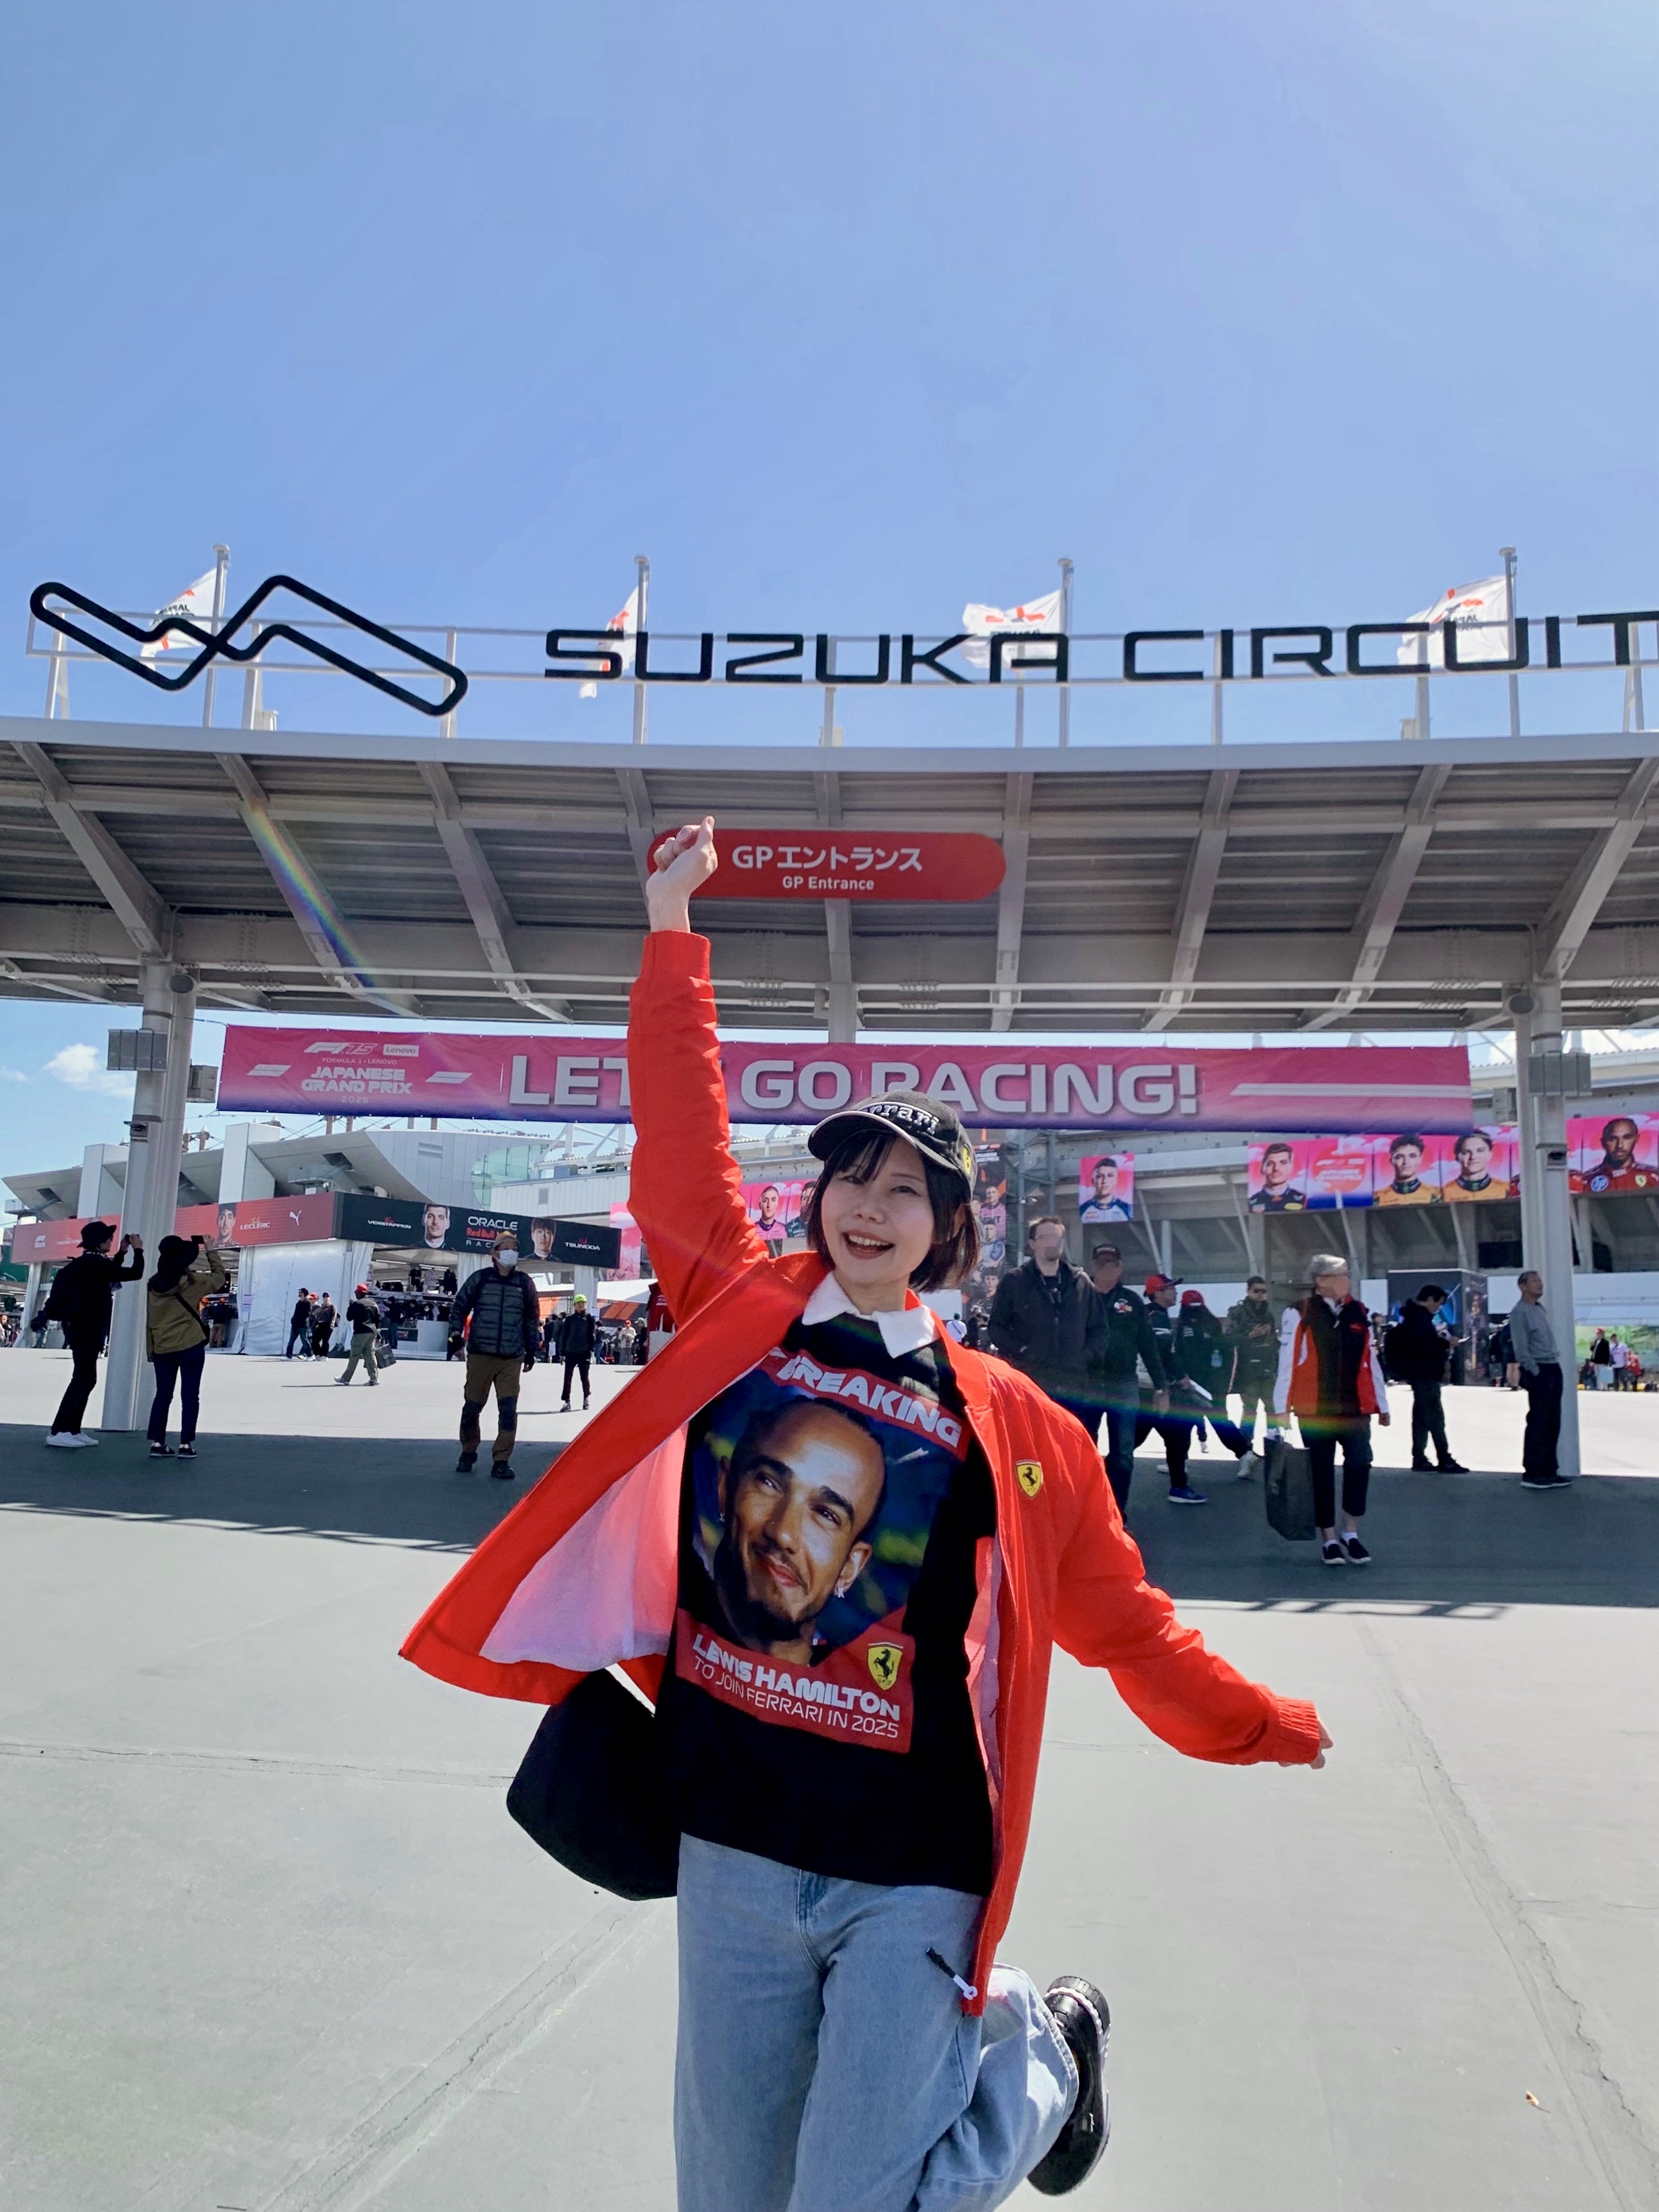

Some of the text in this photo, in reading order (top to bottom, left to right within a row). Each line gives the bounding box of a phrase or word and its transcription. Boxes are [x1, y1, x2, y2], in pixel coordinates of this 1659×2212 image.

[545, 611, 1659, 684] SUZUKA CIRCUIT
[782, 875, 875, 890] GP Entrance
[311, 1066, 405, 1081] JAPANESE
[301, 1079, 413, 1094] GRAND PRIX
[741, 1060, 852, 1110] GO
[871, 1061, 1197, 1115] RACING!
[341, 1095, 369, 1103] 2025
[240, 1222, 271, 1230] LECLERC
[367, 1220, 412, 1229] VERSTAPPEN
[467, 1216, 518, 1231] ORACLE
[467, 1227, 495, 1239] Red Bull
[564, 1242, 600, 1251] TSUNODA
[692, 1634, 900, 1721] LEWIS HAMILTON
[694, 1655, 899, 1739] TO JOIN FERRARI IN 2025
